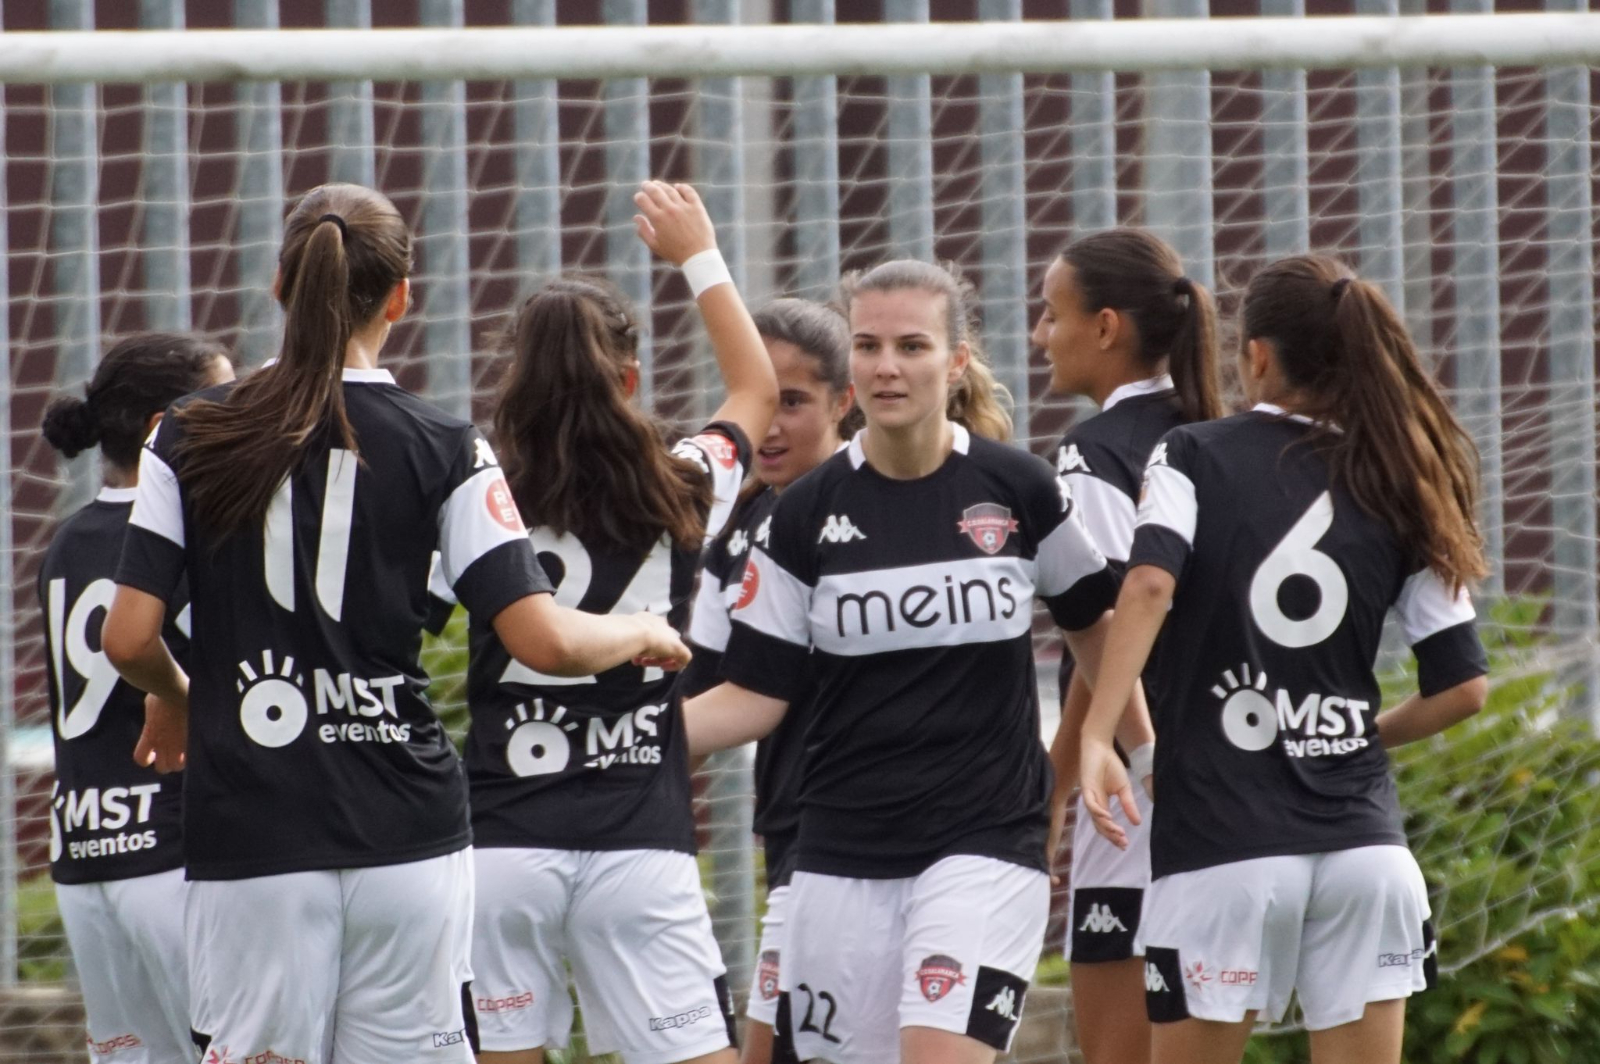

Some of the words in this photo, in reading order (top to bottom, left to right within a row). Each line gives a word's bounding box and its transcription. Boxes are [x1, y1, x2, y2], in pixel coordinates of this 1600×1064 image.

[264, 448, 357, 622] 11
[1250, 489, 1348, 648] 6
[836, 574, 1017, 638] meins
[49, 577, 120, 740] 19
[313, 668, 405, 719] MST
[1276, 688, 1371, 738] MST
[318, 719, 412, 744] eventos
[64, 783, 161, 833] MST
[68, 829, 157, 860] eventos
[648, 1005, 712, 1032] Kappa
[797, 982, 842, 1044] 22
